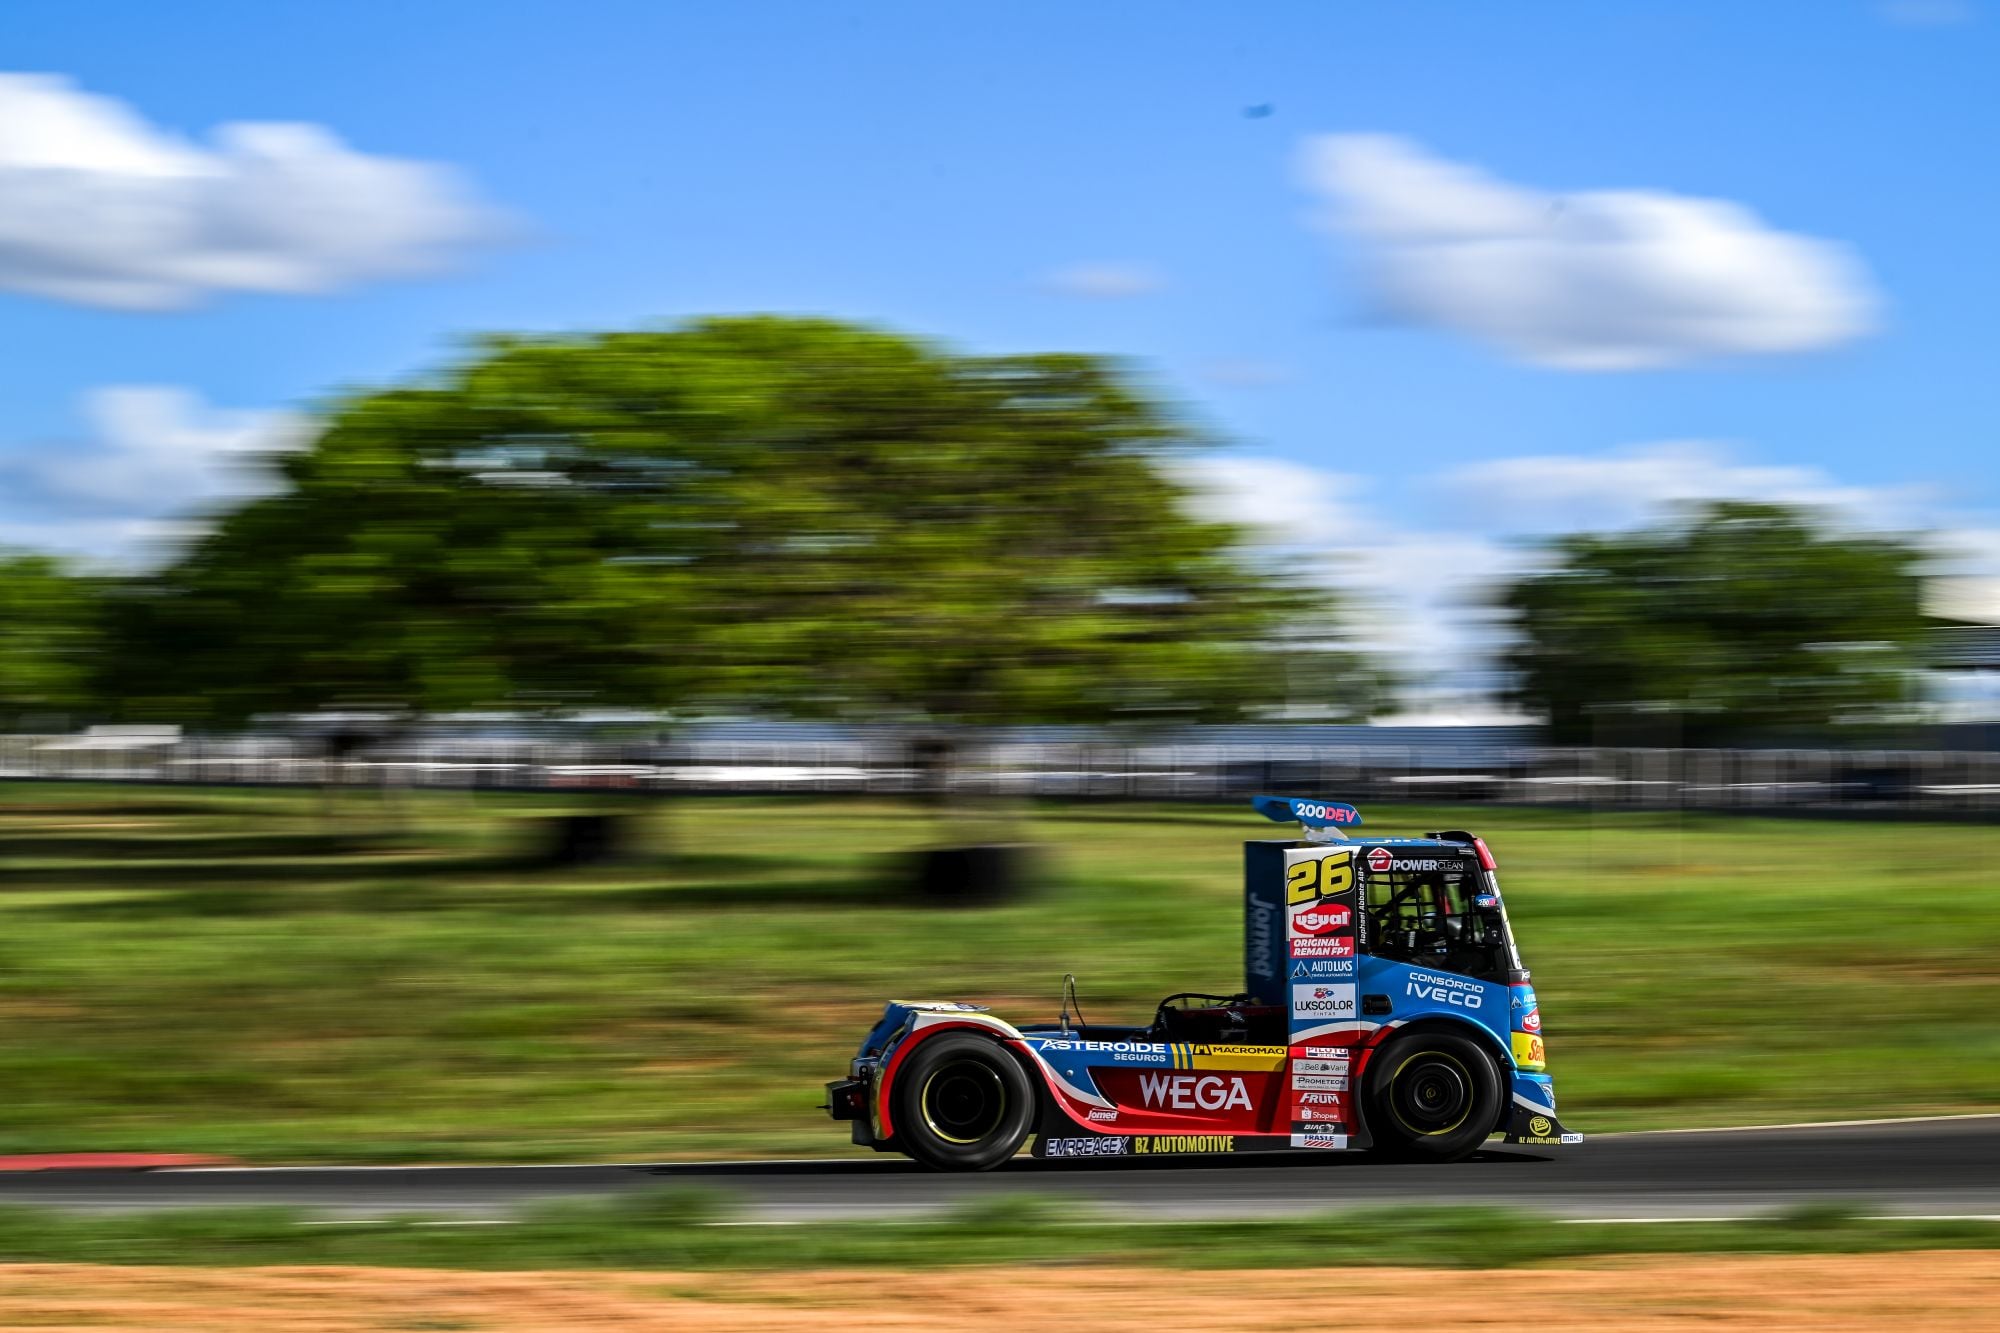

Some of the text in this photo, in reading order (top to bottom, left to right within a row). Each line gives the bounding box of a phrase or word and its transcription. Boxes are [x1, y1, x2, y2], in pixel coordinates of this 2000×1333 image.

[1296, 803, 1356, 823] 200DEV
[1287, 851, 1354, 905] 26
[1295, 912, 1348, 928] usual
[1293, 938, 1340, 947] ORIGINAL
[1293, 946, 1351, 956] REMAN FPT
[1311, 960, 1353, 972] AUTOLUKS
[1409, 972, 1484, 994] CONSÓRCIO
[1406, 982, 1482, 1009] IVECO
[1294, 1000, 1354, 1011] LUKSCOLOR
[1039, 1038, 1166, 1053] ASTEROIDE
[1212, 1046, 1285, 1055] MACROMAQ
[1113, 1053, 1166, 1062] SEGUROS
[1296, 1076, 1346, 1085] PROMETEON
[1138, 1071, 1253, 1111] WEGA
[1299, 1092, 1340, 1104] FRUM
[1312, 1111, 1338, 1120] Shopee
[1135, 1135, 1234, 1154] BZ AUTOMOTIVE
